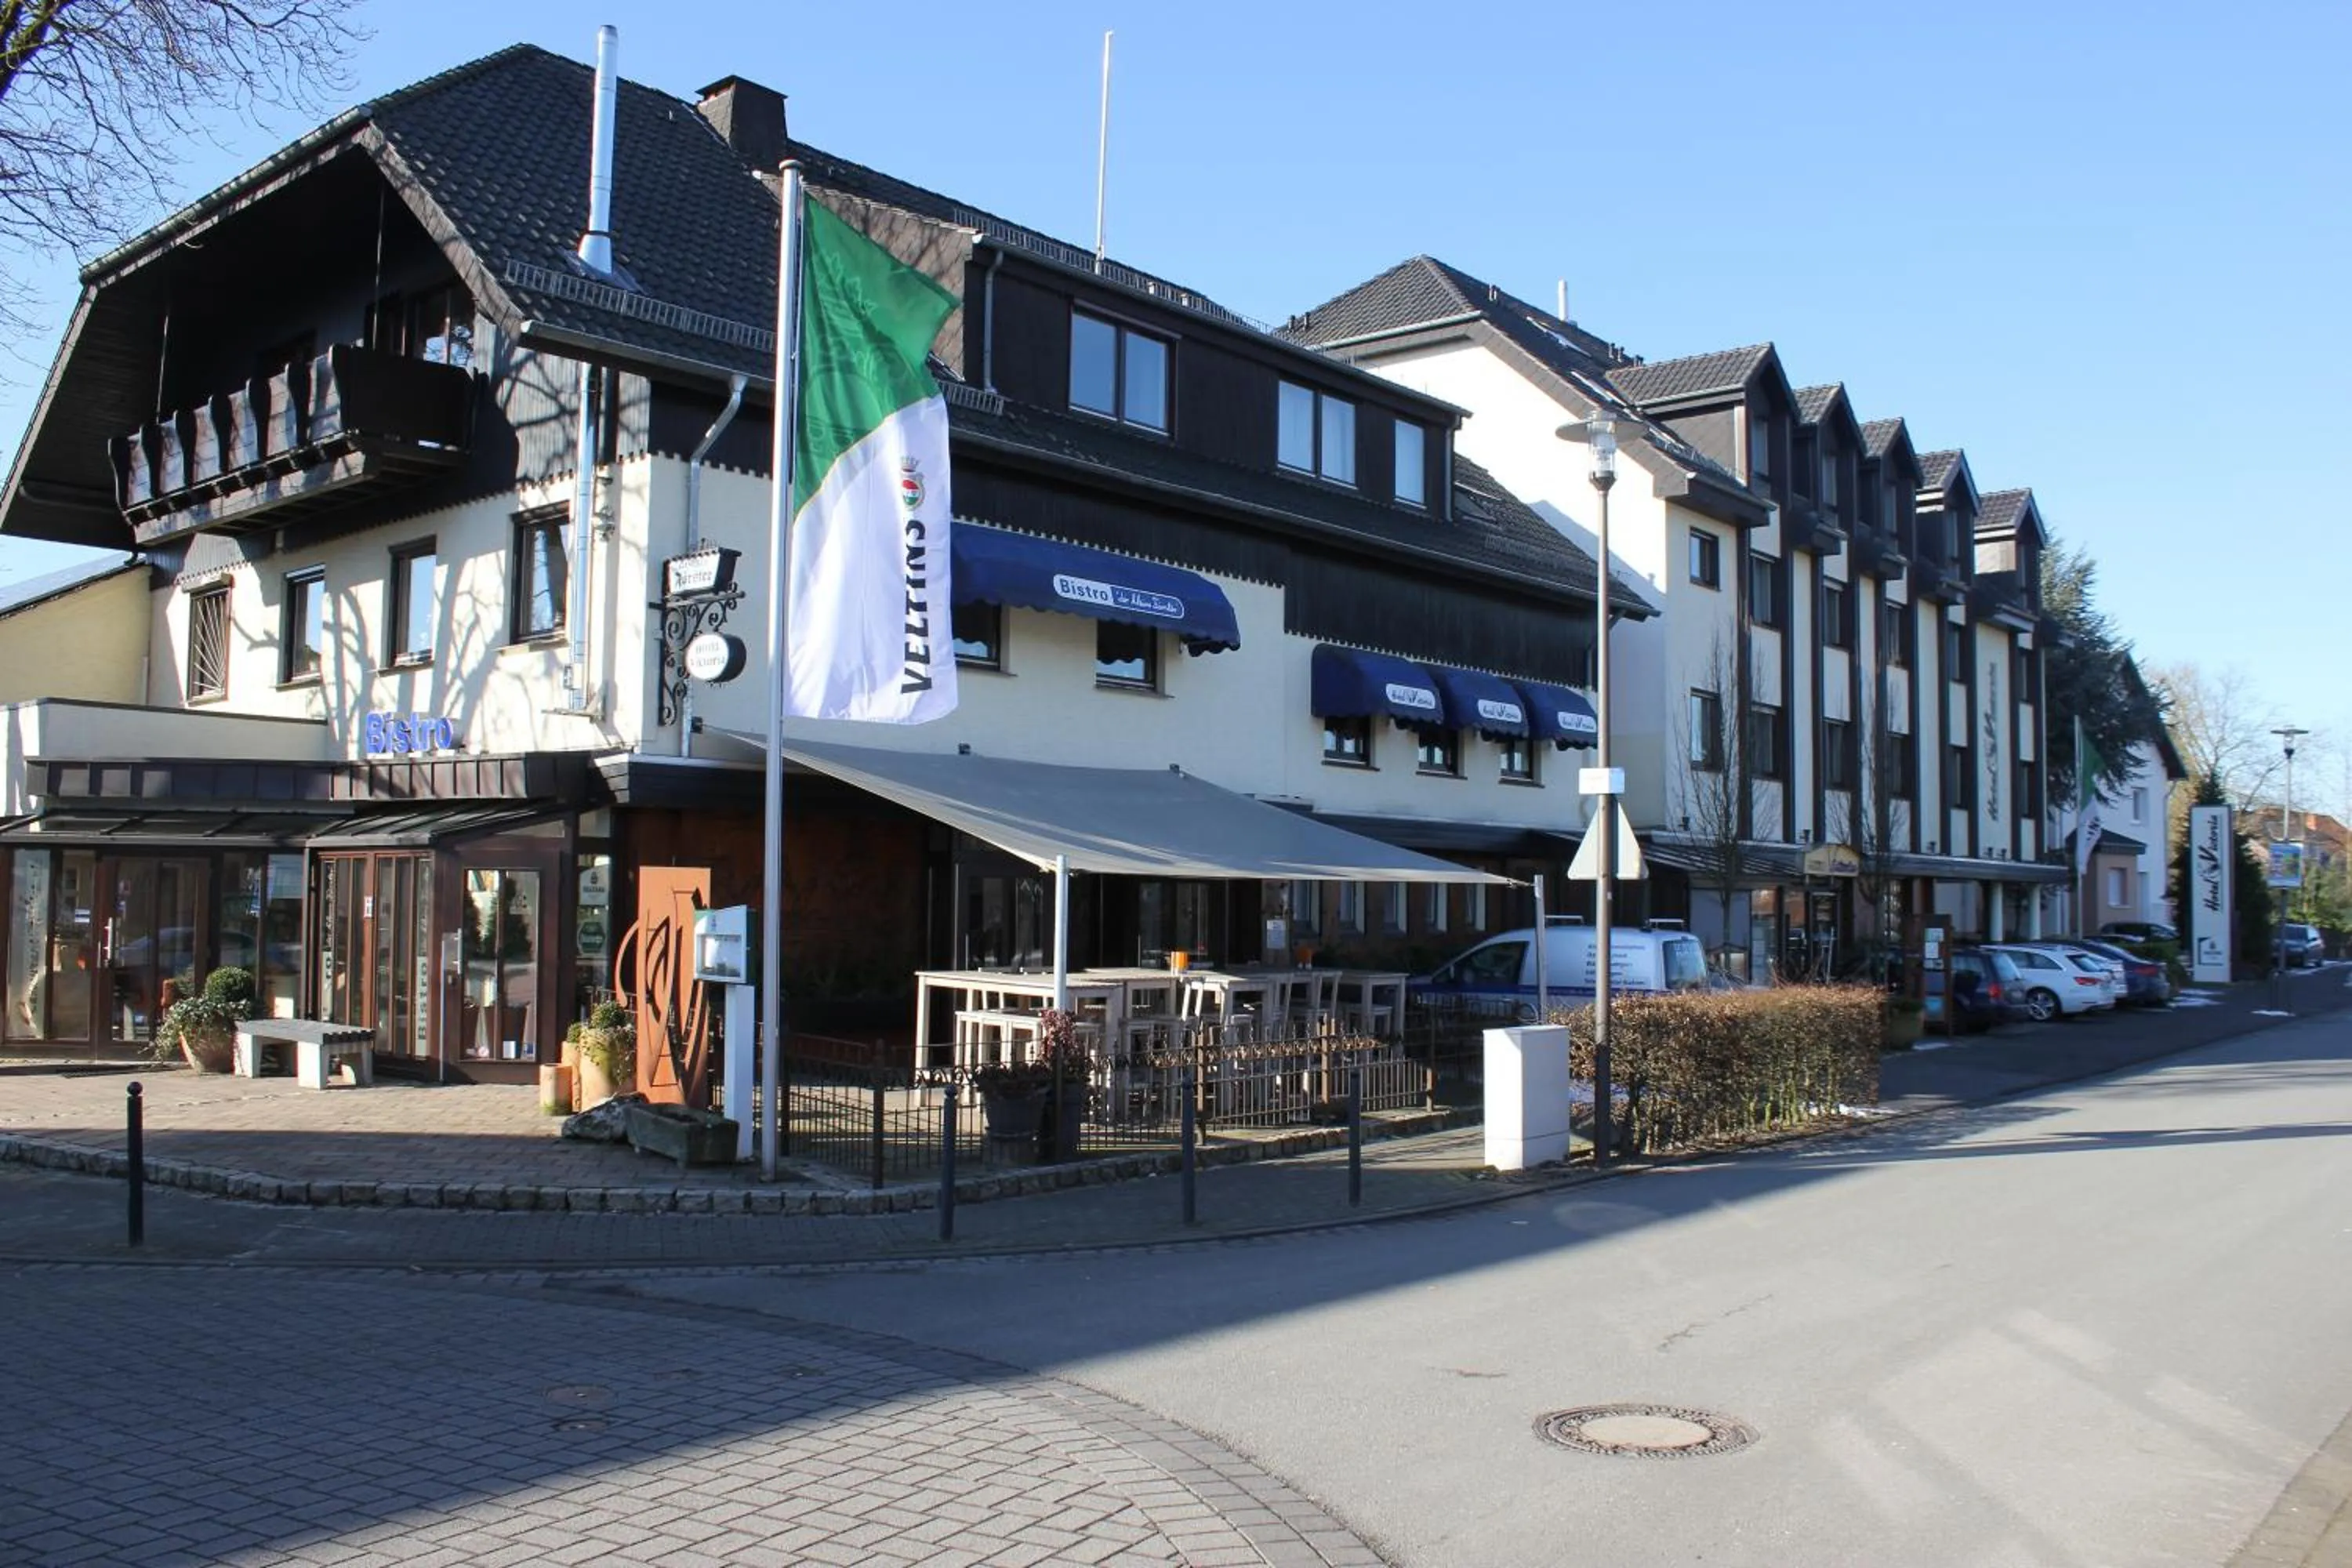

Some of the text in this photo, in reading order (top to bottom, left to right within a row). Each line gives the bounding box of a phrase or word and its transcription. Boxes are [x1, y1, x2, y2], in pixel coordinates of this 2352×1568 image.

[900, 520, 932, 694] VELTINS
[1059, 578, 1108, 601] Bistro
[367, 711, 453, 753] Bistro
[2198, 815, 2220, 912] Hotel Victoria
[419, 962, 428, 1040] Bistro
